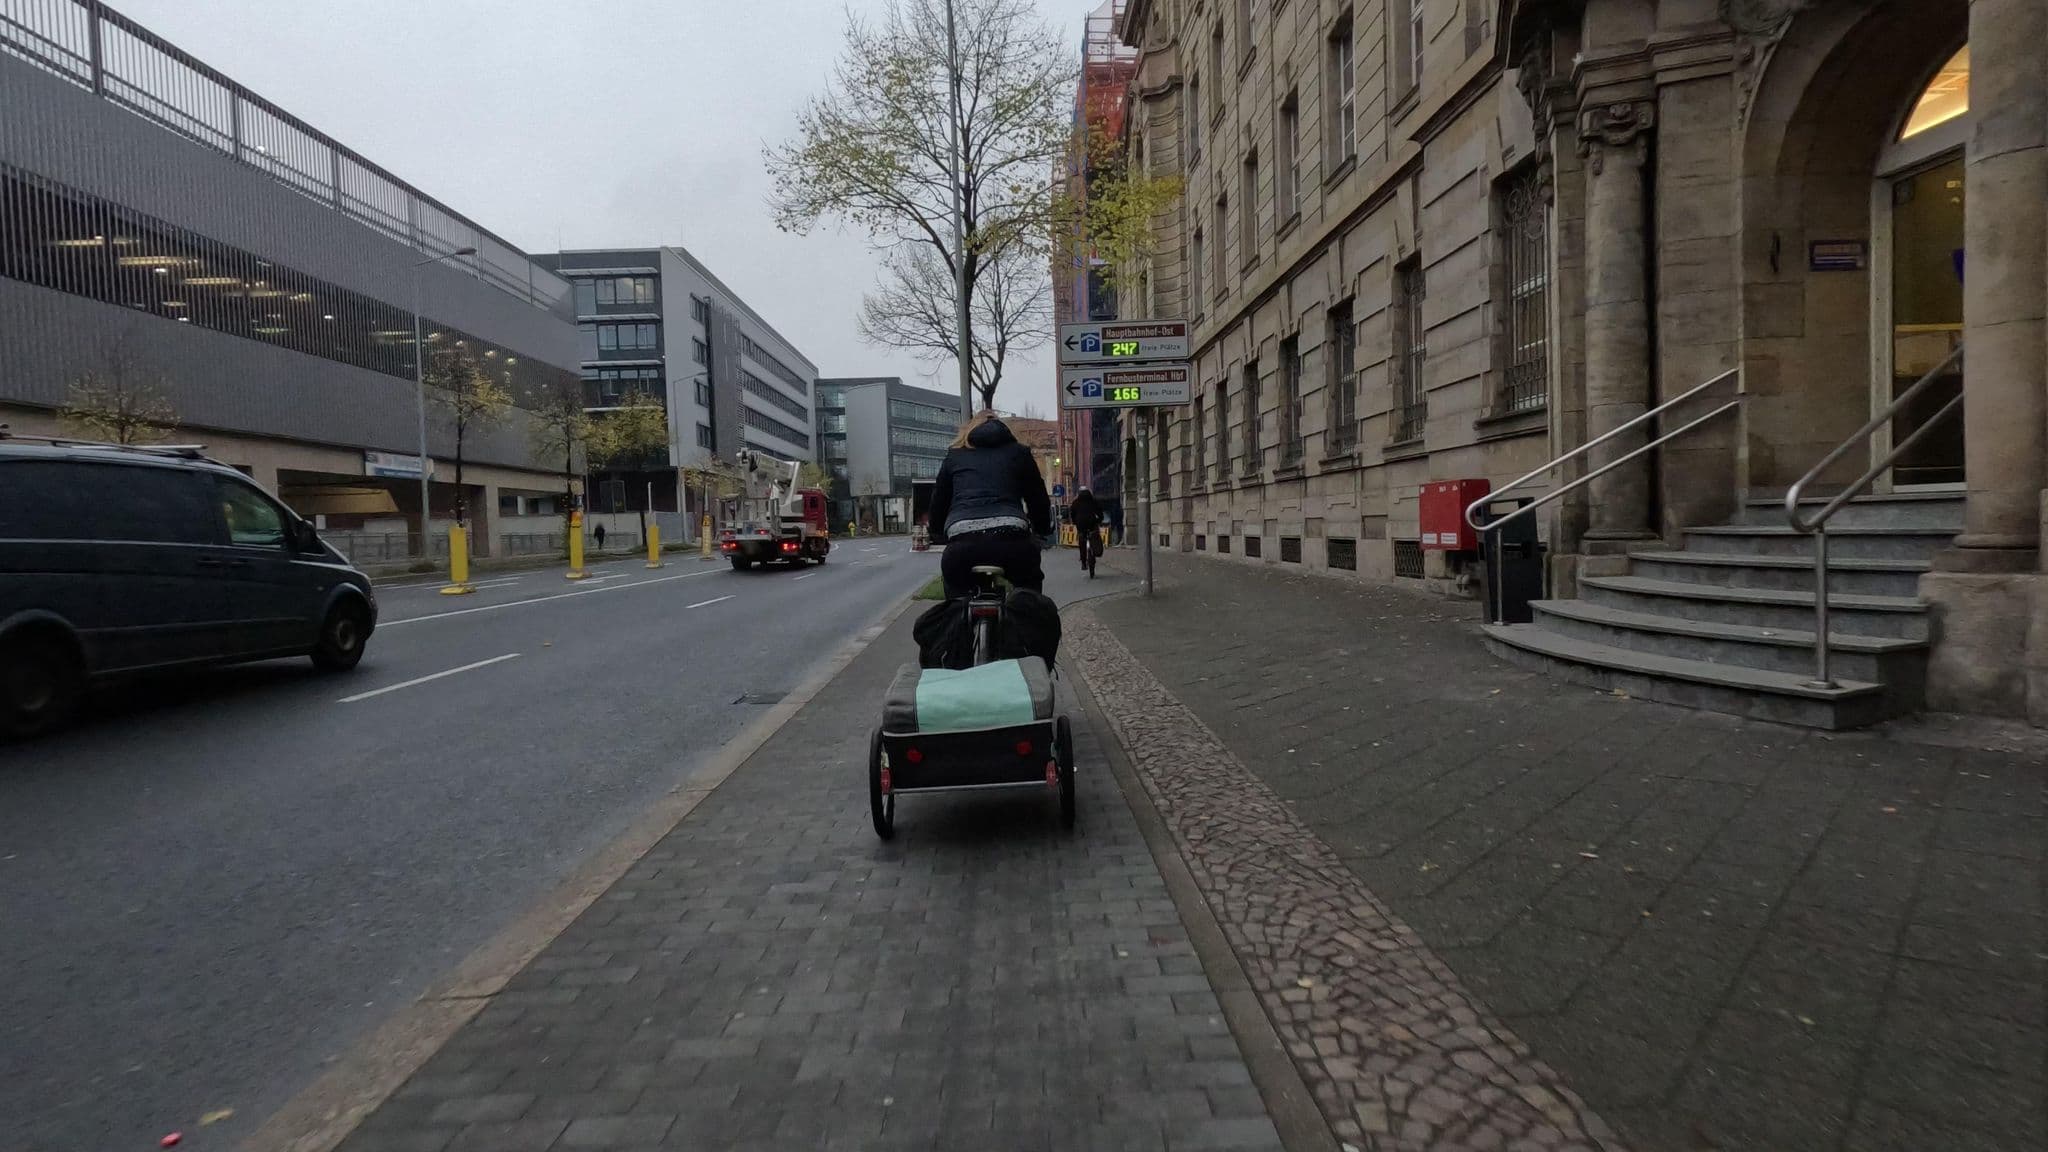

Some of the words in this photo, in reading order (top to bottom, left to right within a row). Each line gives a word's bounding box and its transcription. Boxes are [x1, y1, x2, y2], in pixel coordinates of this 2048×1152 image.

[1106, 326, 1174, 339] Hauptbahnhof-Ost
[1112, 342, 1137, 356] 247
[1107, 373, 1168, 384] Fernbusterminal
[1114, 387, 1139, 400] 166
